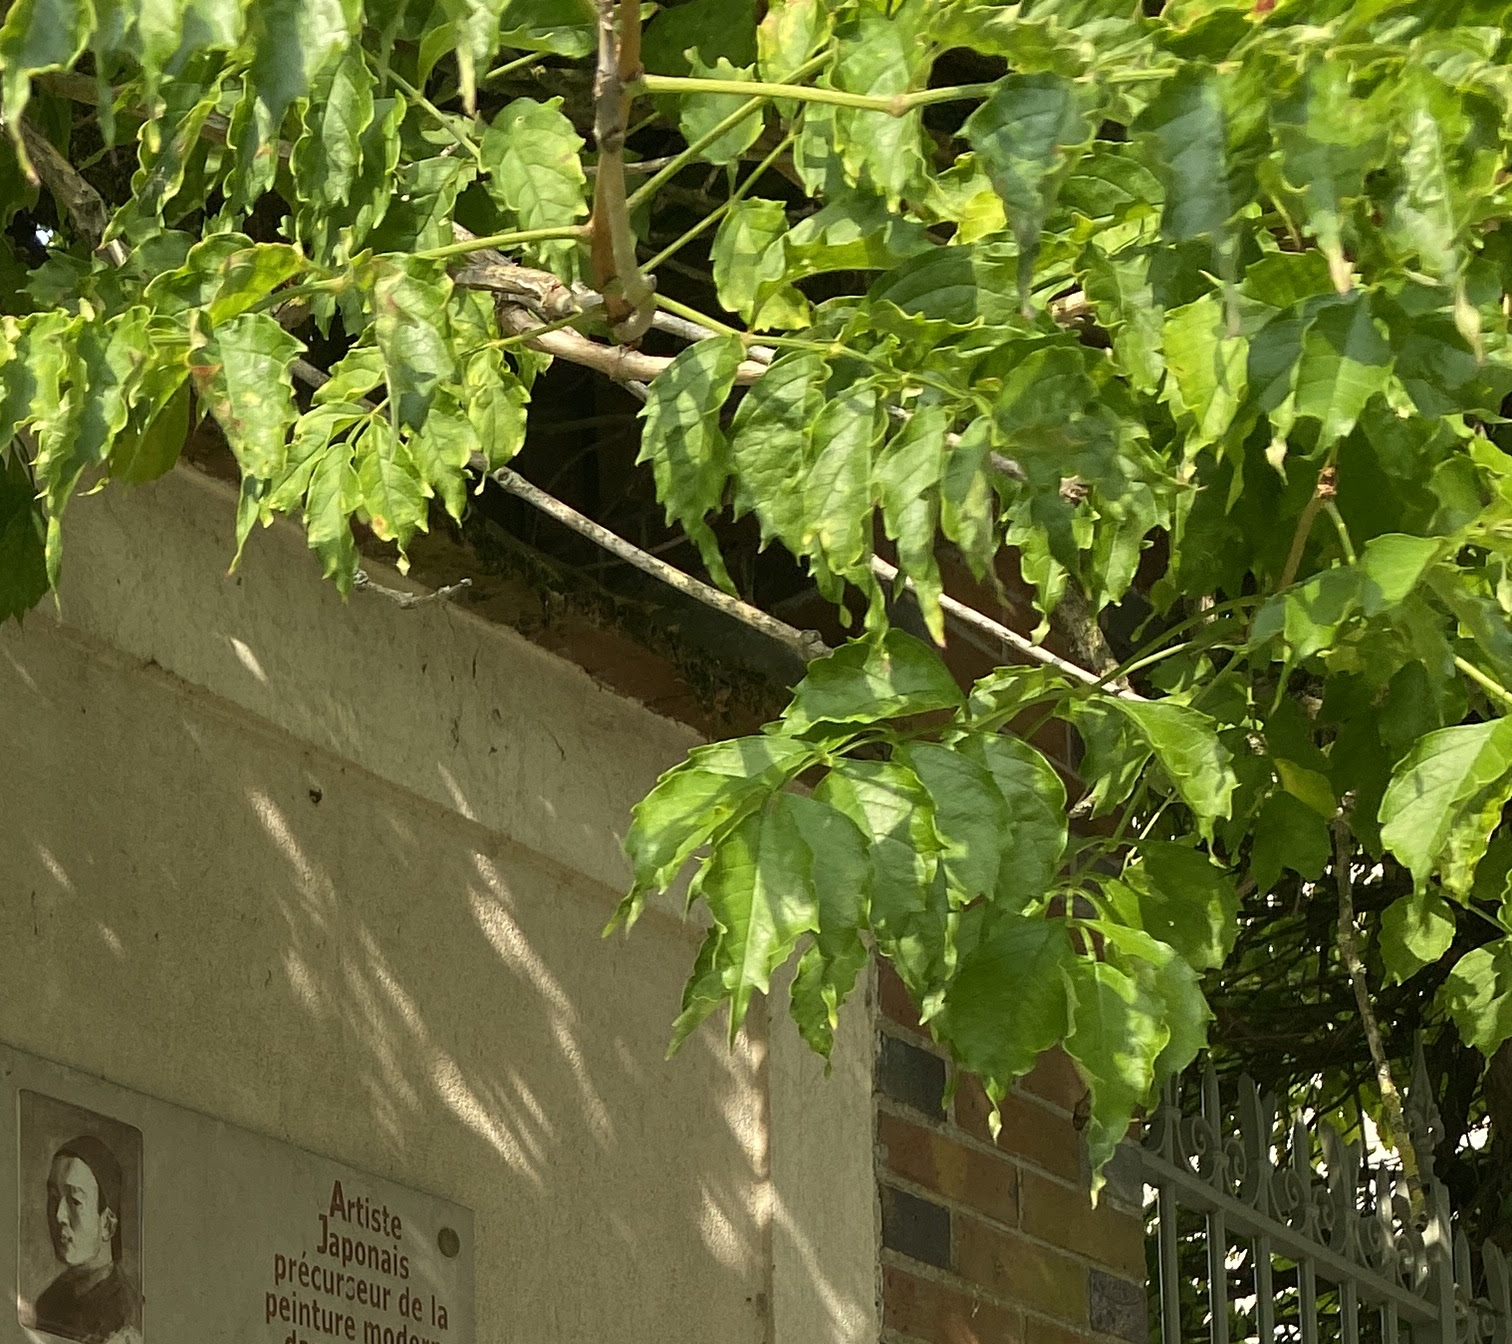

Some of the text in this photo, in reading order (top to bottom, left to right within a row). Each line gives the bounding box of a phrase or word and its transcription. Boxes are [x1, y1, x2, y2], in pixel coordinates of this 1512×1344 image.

[329, 1179, 402, 1241] Artiste
[316, 1213, 410, 1280] Japonais
[265, 1291, 356, 1341] peinture
[274, 1250, 449, 1330] précurseur de la
